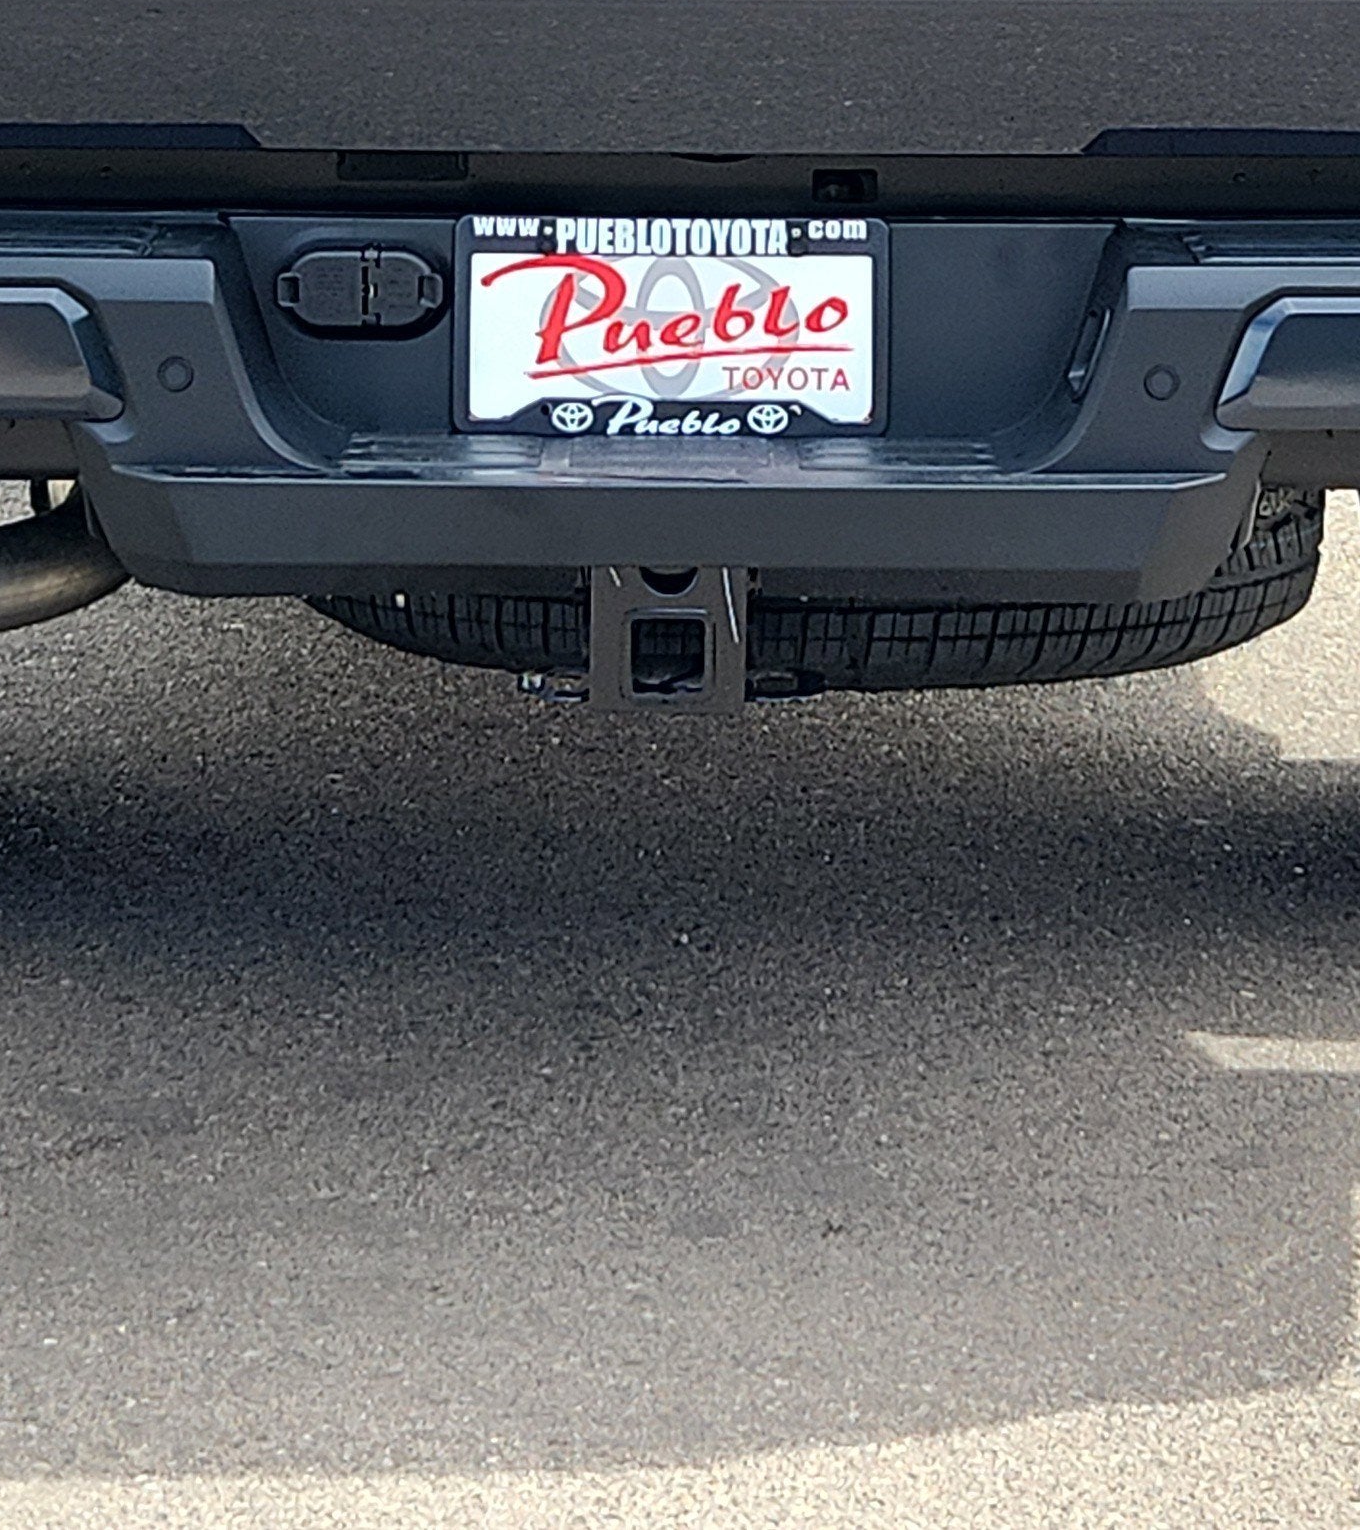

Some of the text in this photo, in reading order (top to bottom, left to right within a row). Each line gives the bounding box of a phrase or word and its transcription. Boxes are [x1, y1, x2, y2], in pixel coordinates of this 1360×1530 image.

[480, 253, 849, 365] Pueblo
[722, 366, 851, 392] TOYOTA
[591, 392, 741, 437] Pueblo
